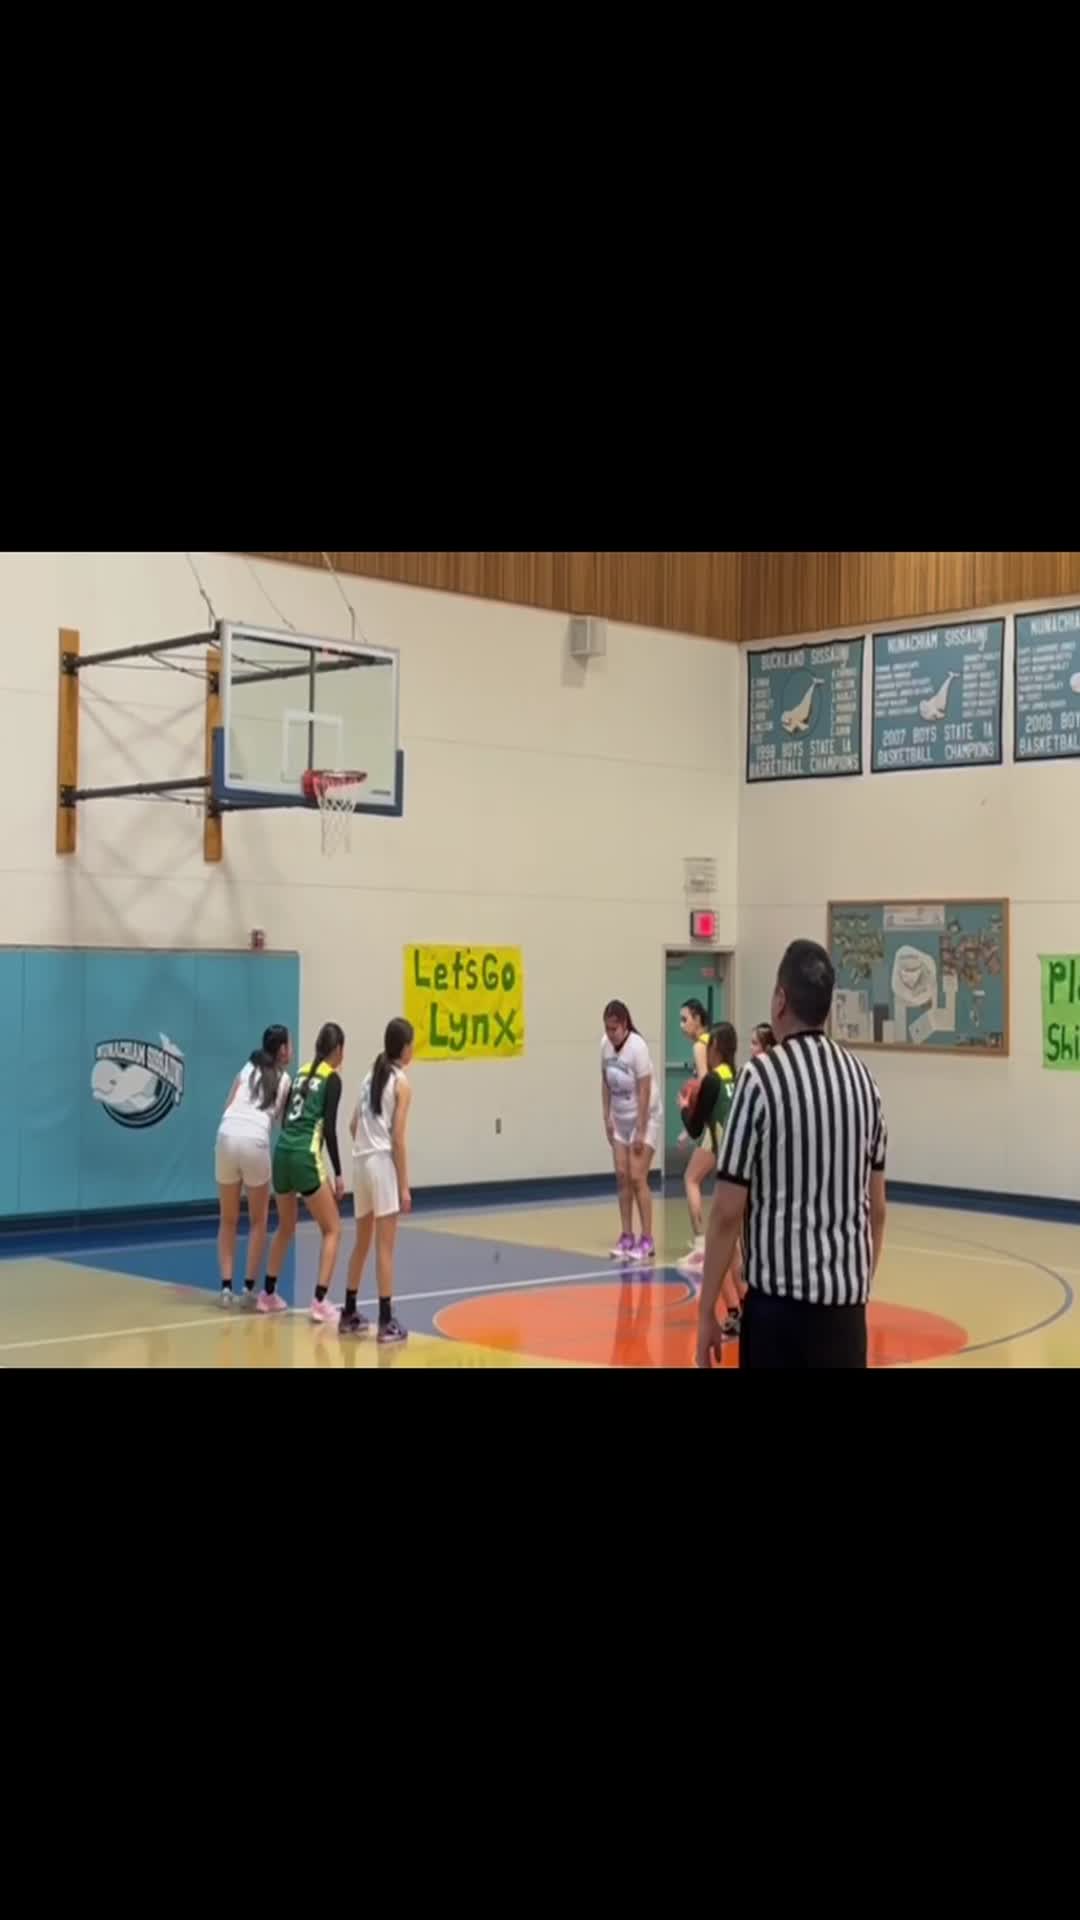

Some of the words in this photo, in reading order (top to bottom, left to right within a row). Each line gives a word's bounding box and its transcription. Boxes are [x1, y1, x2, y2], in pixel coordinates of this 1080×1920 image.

[882, 727, 906, 747] 2007
[912, 726, 937, 744] BOYS
[944, 723, 973, 742] STATE
[782, 741, 803, 759] BOYS
[810, 739, 834, 756] STATE
[877, 745, 934, 766] BASKETBALL
[944, 741, 994, 760] CHAMPIONS
[750, 757, 803, 778] BASKETBALL
[810, 752, 860, 774] CHAMPIONS
[429, 1001, 518, 1052] Lynx
[288, 1093, 304, 1121] 3
